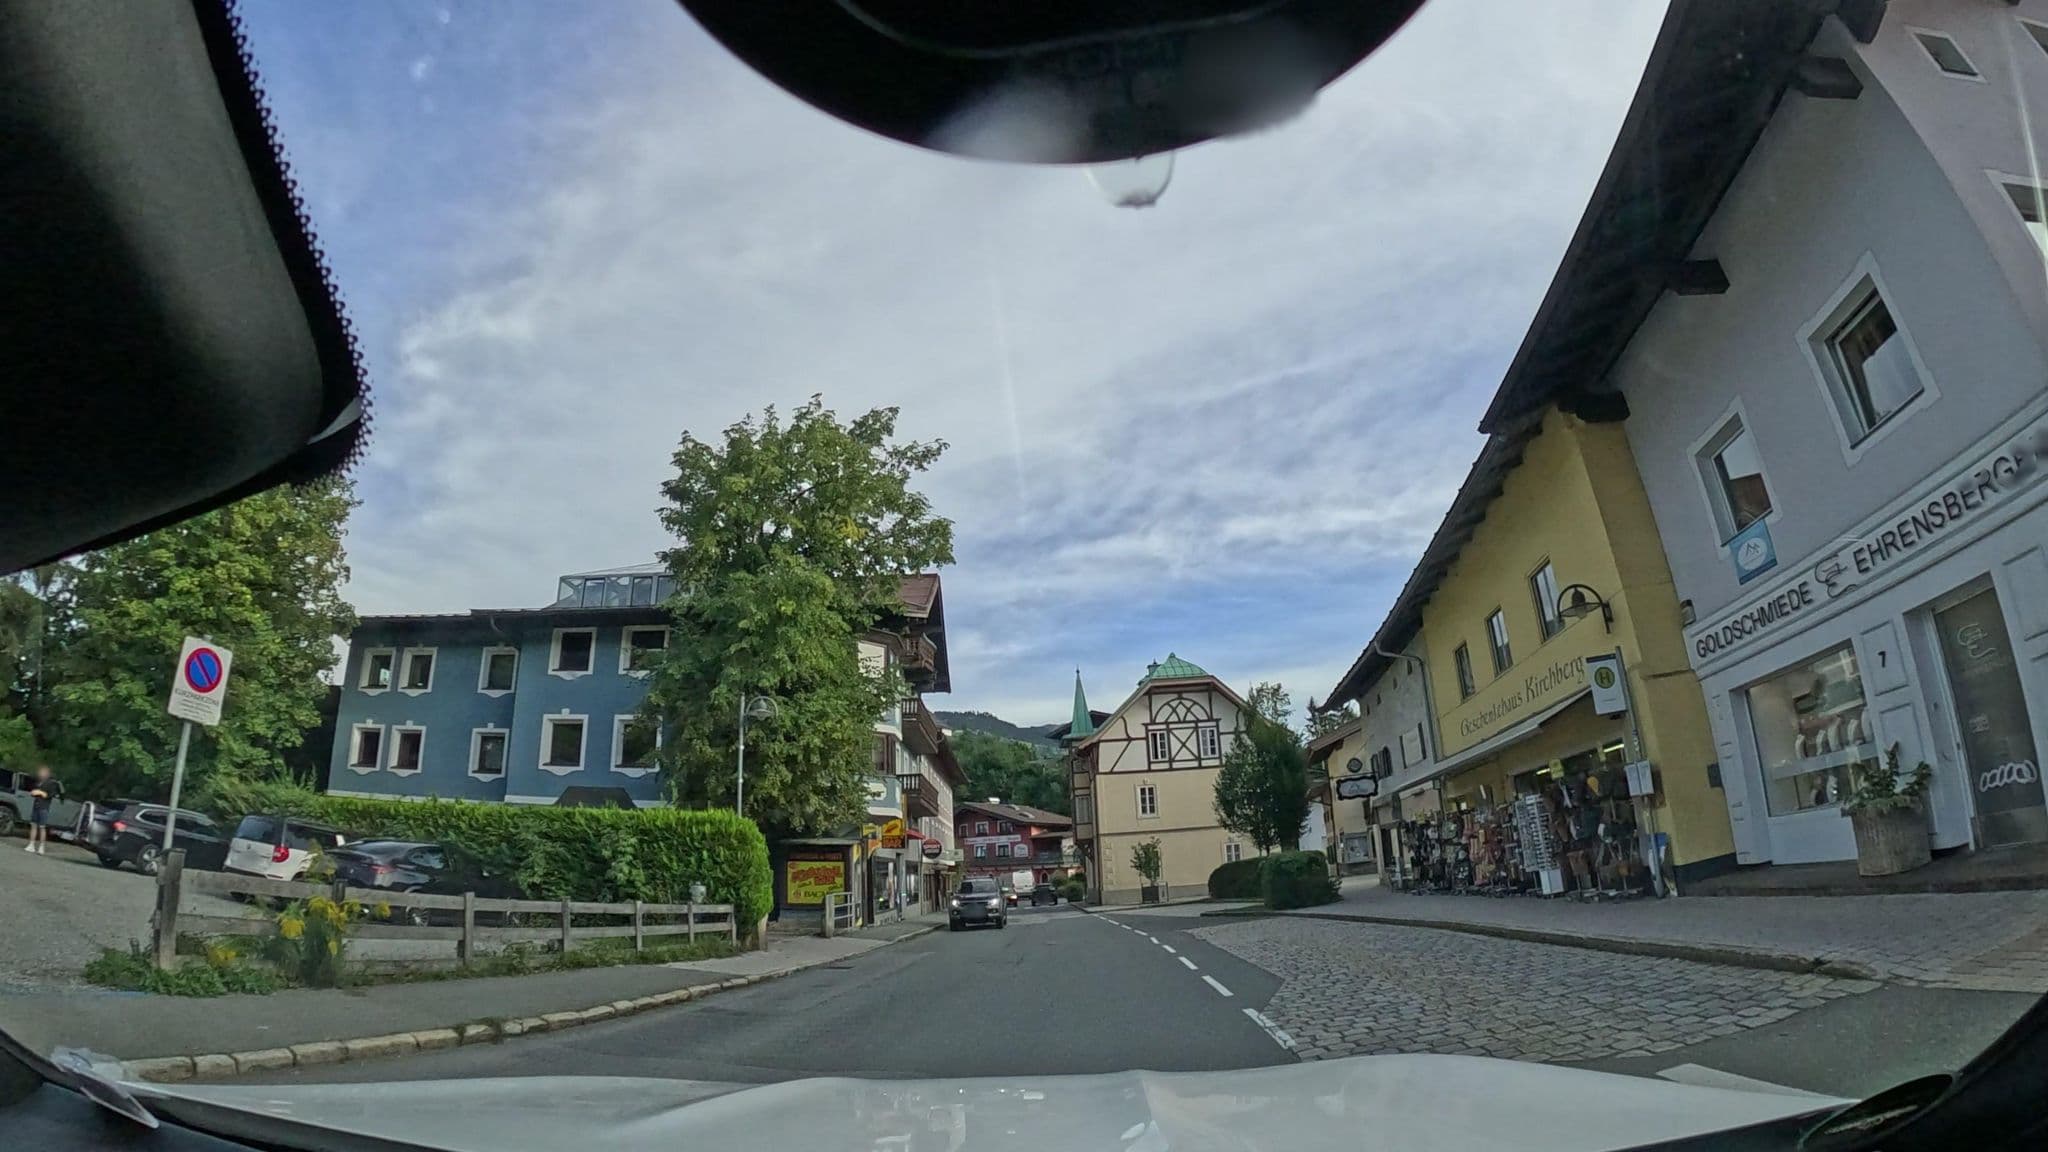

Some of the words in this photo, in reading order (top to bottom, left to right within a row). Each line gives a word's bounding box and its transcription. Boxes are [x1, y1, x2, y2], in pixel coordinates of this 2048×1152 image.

[1696, 581, 1814, 658] GOLDSCHMIEDE
[1524, 656, 1585, 702] Kirchberg
[1877, 650, 1887, 669] 7
